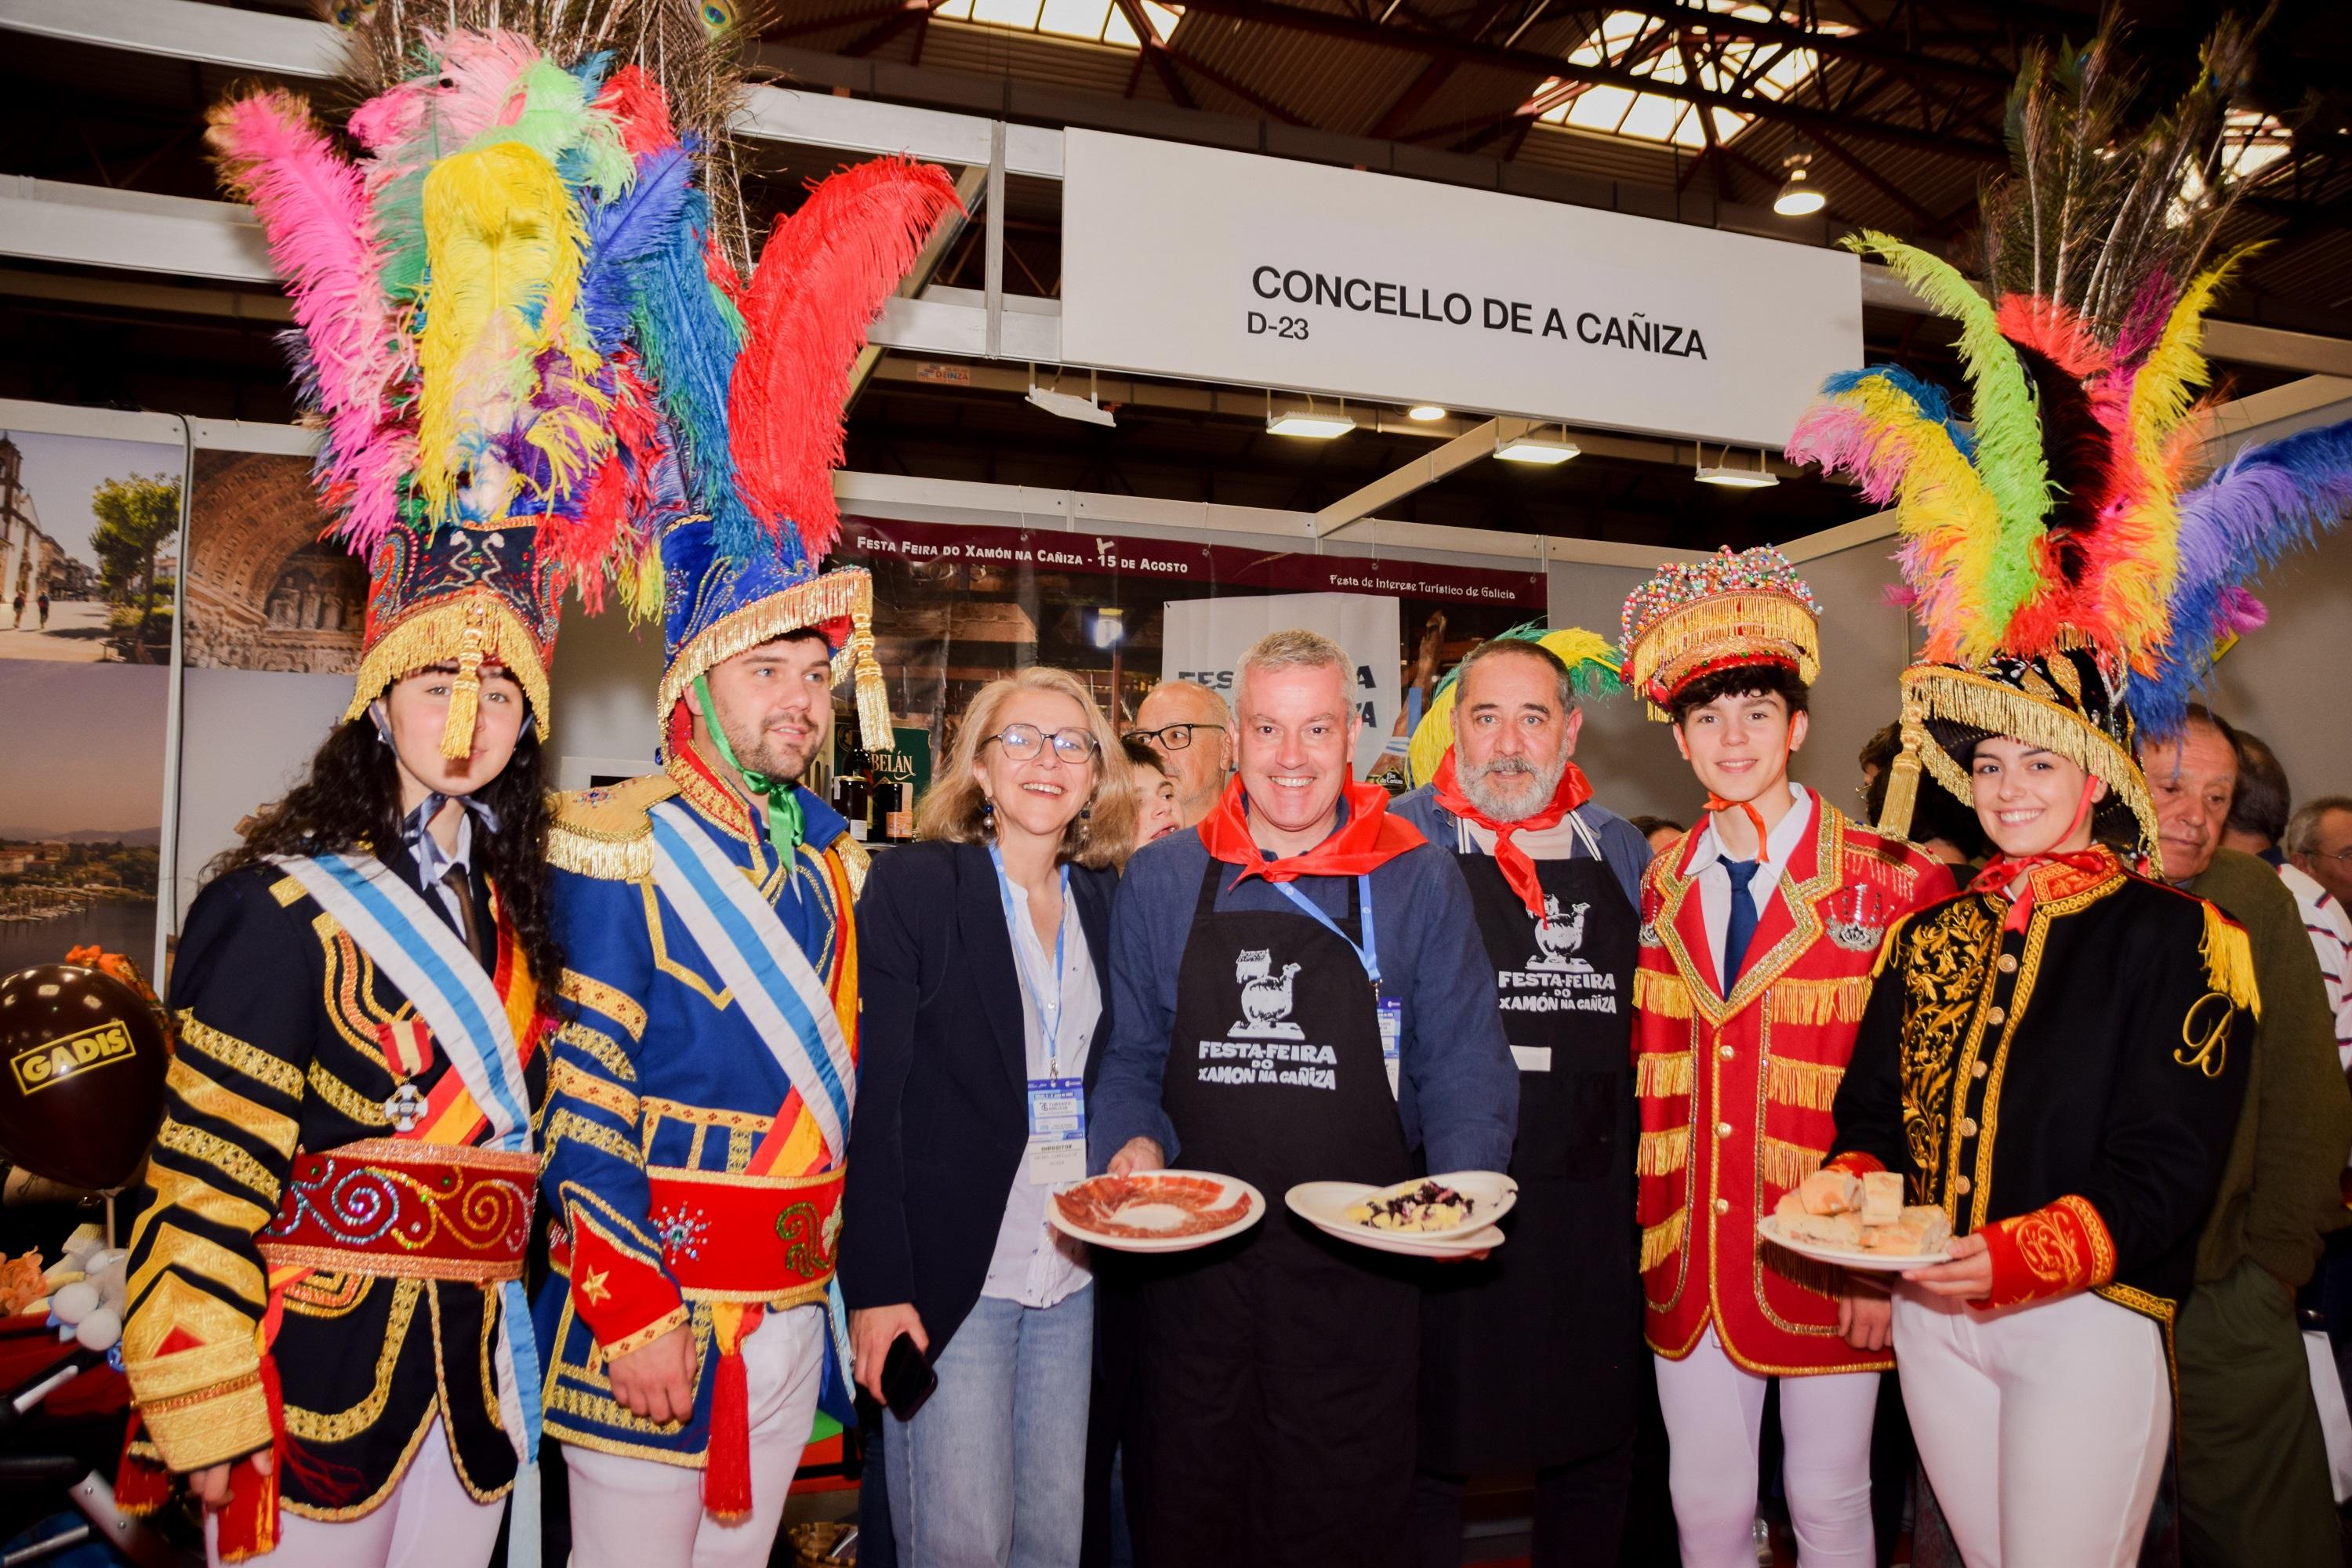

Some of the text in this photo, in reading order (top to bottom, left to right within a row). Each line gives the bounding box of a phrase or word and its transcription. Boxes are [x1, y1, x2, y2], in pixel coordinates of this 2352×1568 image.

[1252, 265, 1708, 361] CONCELLO DE A CAÑIZA
[1247, 311, 1309, 341] D-23
[857, 536, 896, 552] FESTA
[902, 541, 938, 556] FEIRA
[965, 544, 1012, 560] XAMÓN
[1037, 550, 1083, 565] CAÑIZA
[1098, 554, 1116, 568] 15
[1140, 557, 1188, 573] AGOSTO
[1330, 574, 1515, 600] Festa de Interese Turístico de Galicia
[1498, 971, 1617, 990] FESTA-FEIRA
[1499, 992, 1558, 1013] XAMÓN
[1560, 998, 1576, 1011] NA
[1554, 989, 1571, 998] DO
[22, 1028, 129, 1083] GADIS
[1198, 1040, 1338, 1065] FESTA-FEIRA
[1251, 1059, 1274, 1069] DO
[1258, 1069, 1278, 1083] NA
